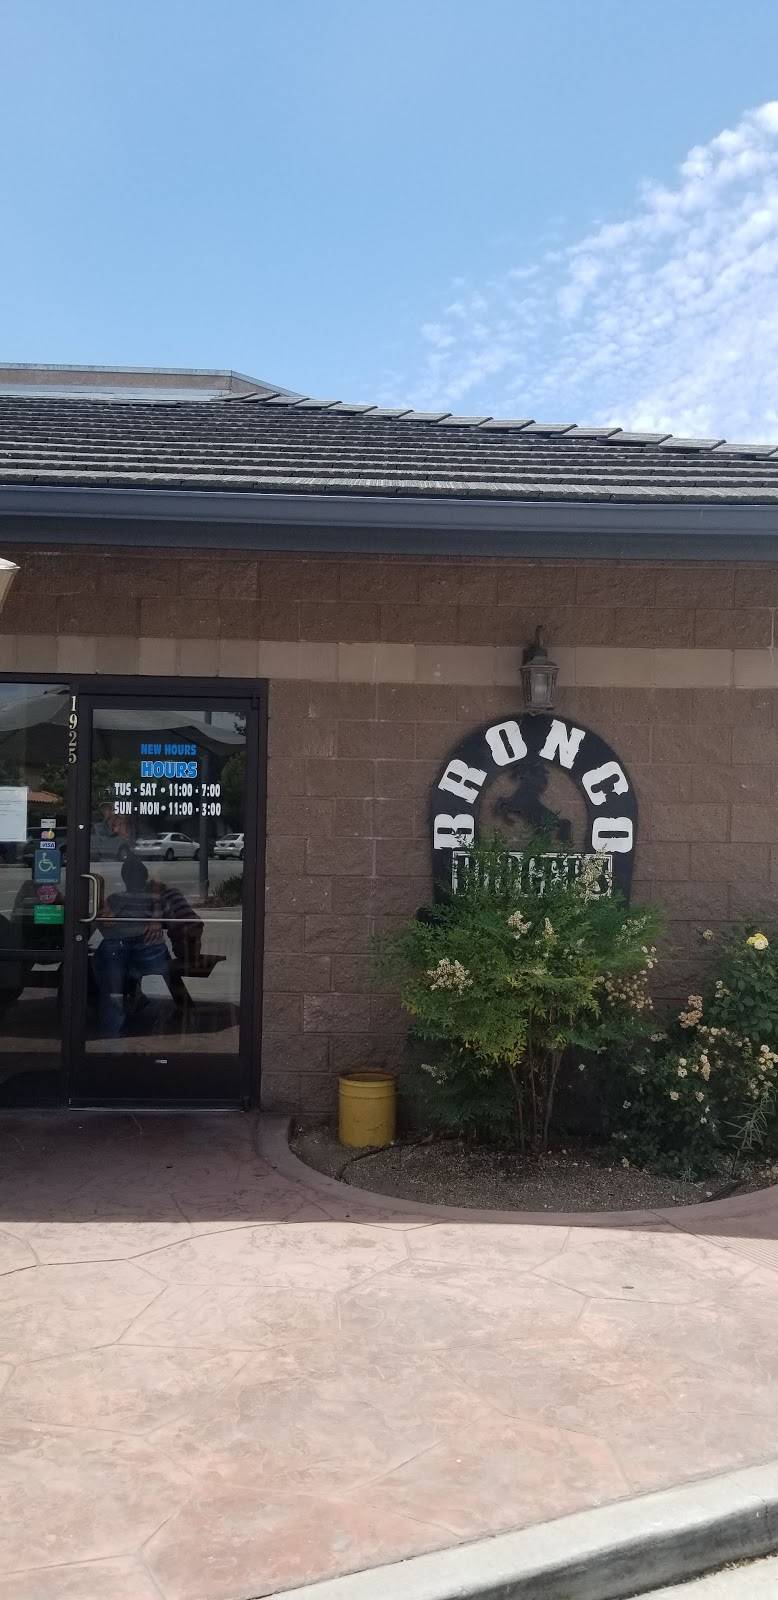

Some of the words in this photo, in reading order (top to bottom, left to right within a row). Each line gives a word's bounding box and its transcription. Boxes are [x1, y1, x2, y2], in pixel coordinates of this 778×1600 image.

[69, 695, 78, 764] 1925
[140, 743, 161, 755] NEW
[164, 744, 197, 755] HOURS
[140, 760, 198, 779] HOURS
[114, 782, 132, 796] TUS
[140, 783, 157, 796] SAT
[168, 783, 193, 797] 11:00
[201, 783, 221, 797] 7:00
[433, 719, 633, 853] BRONCO
[114, 801, 132, 815] SUN
[140, 801, 160, 815] MON
[168, 802, 193, 816] 11:00
[201, 802, 222, 816] 3:00
